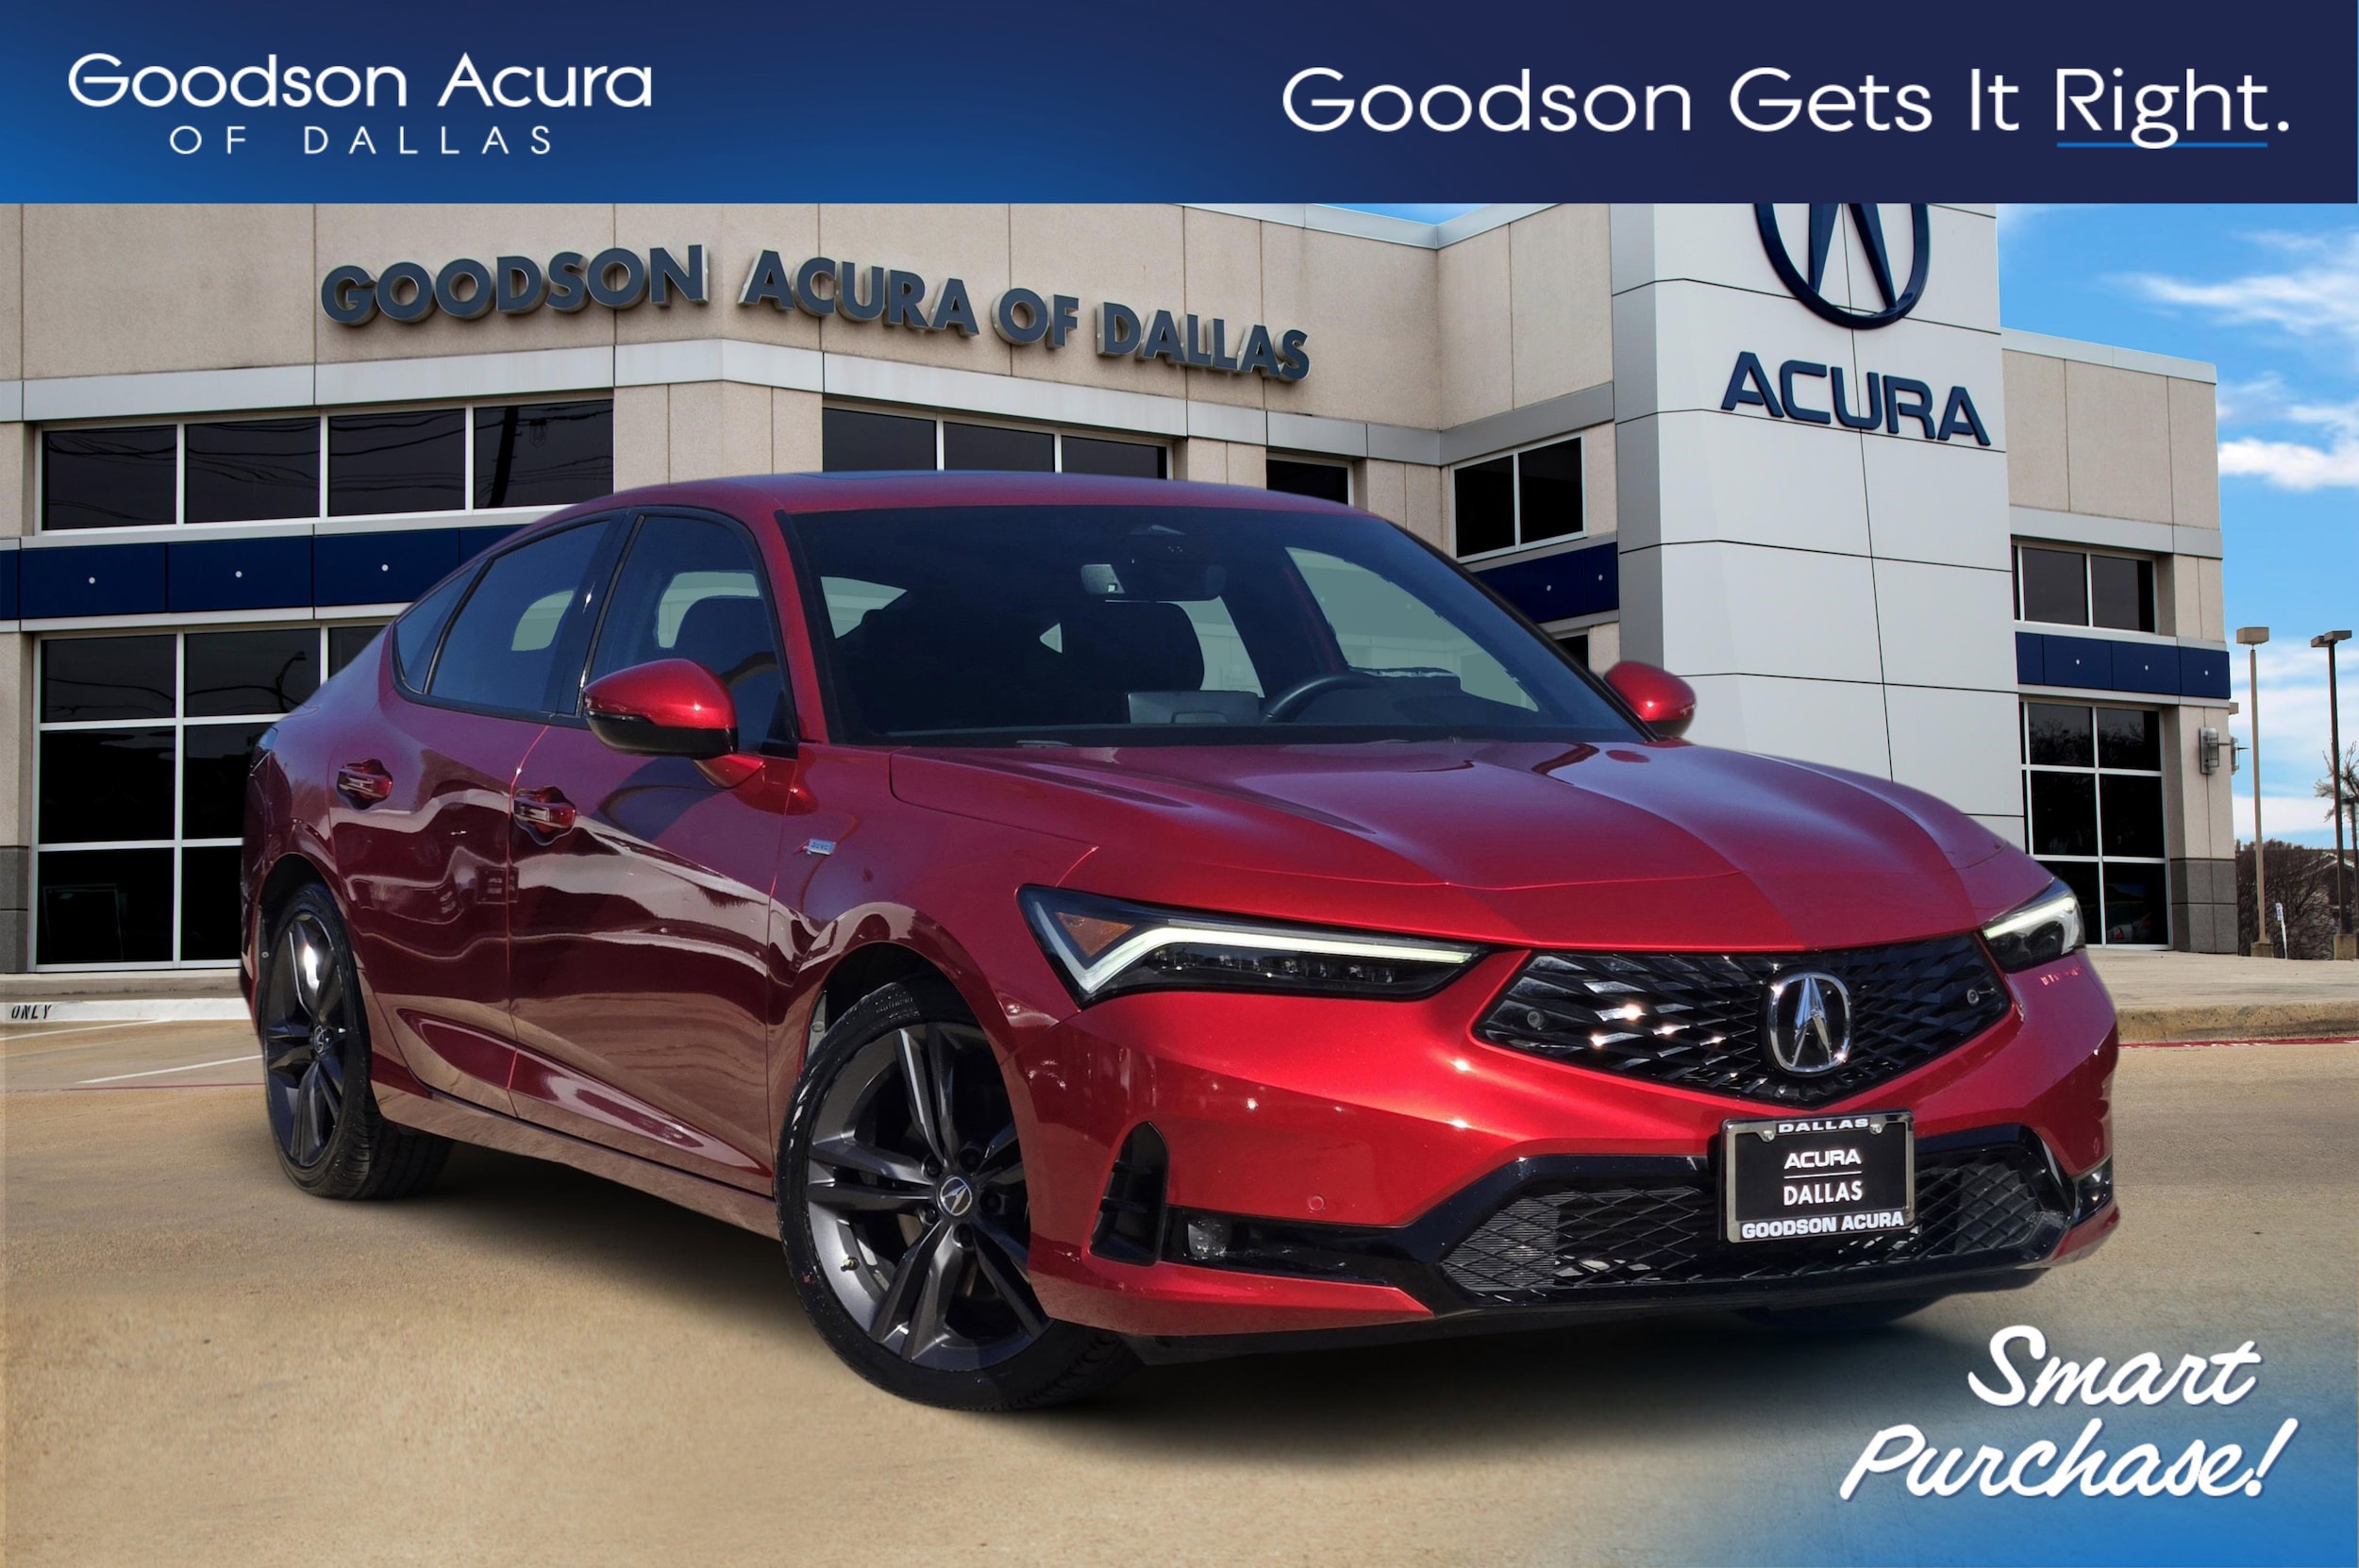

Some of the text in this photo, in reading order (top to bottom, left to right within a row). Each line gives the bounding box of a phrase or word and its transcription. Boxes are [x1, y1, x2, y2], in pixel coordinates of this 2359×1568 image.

[321, 243, 1311, 382] GOODSON ACURA OF DALLAS
[1720, 350, 1992, 446] ACURA
[11, 1004, 52, 1020] ONLY
[1778, 1118, 1869, 1133] DALLAS
[1783, 1149, 1862, 1170] ACURA
[1783, 1180, 1863, 1206] DALLAS
[1742, 1211, 1904, 1240] GOODSON ACURA
